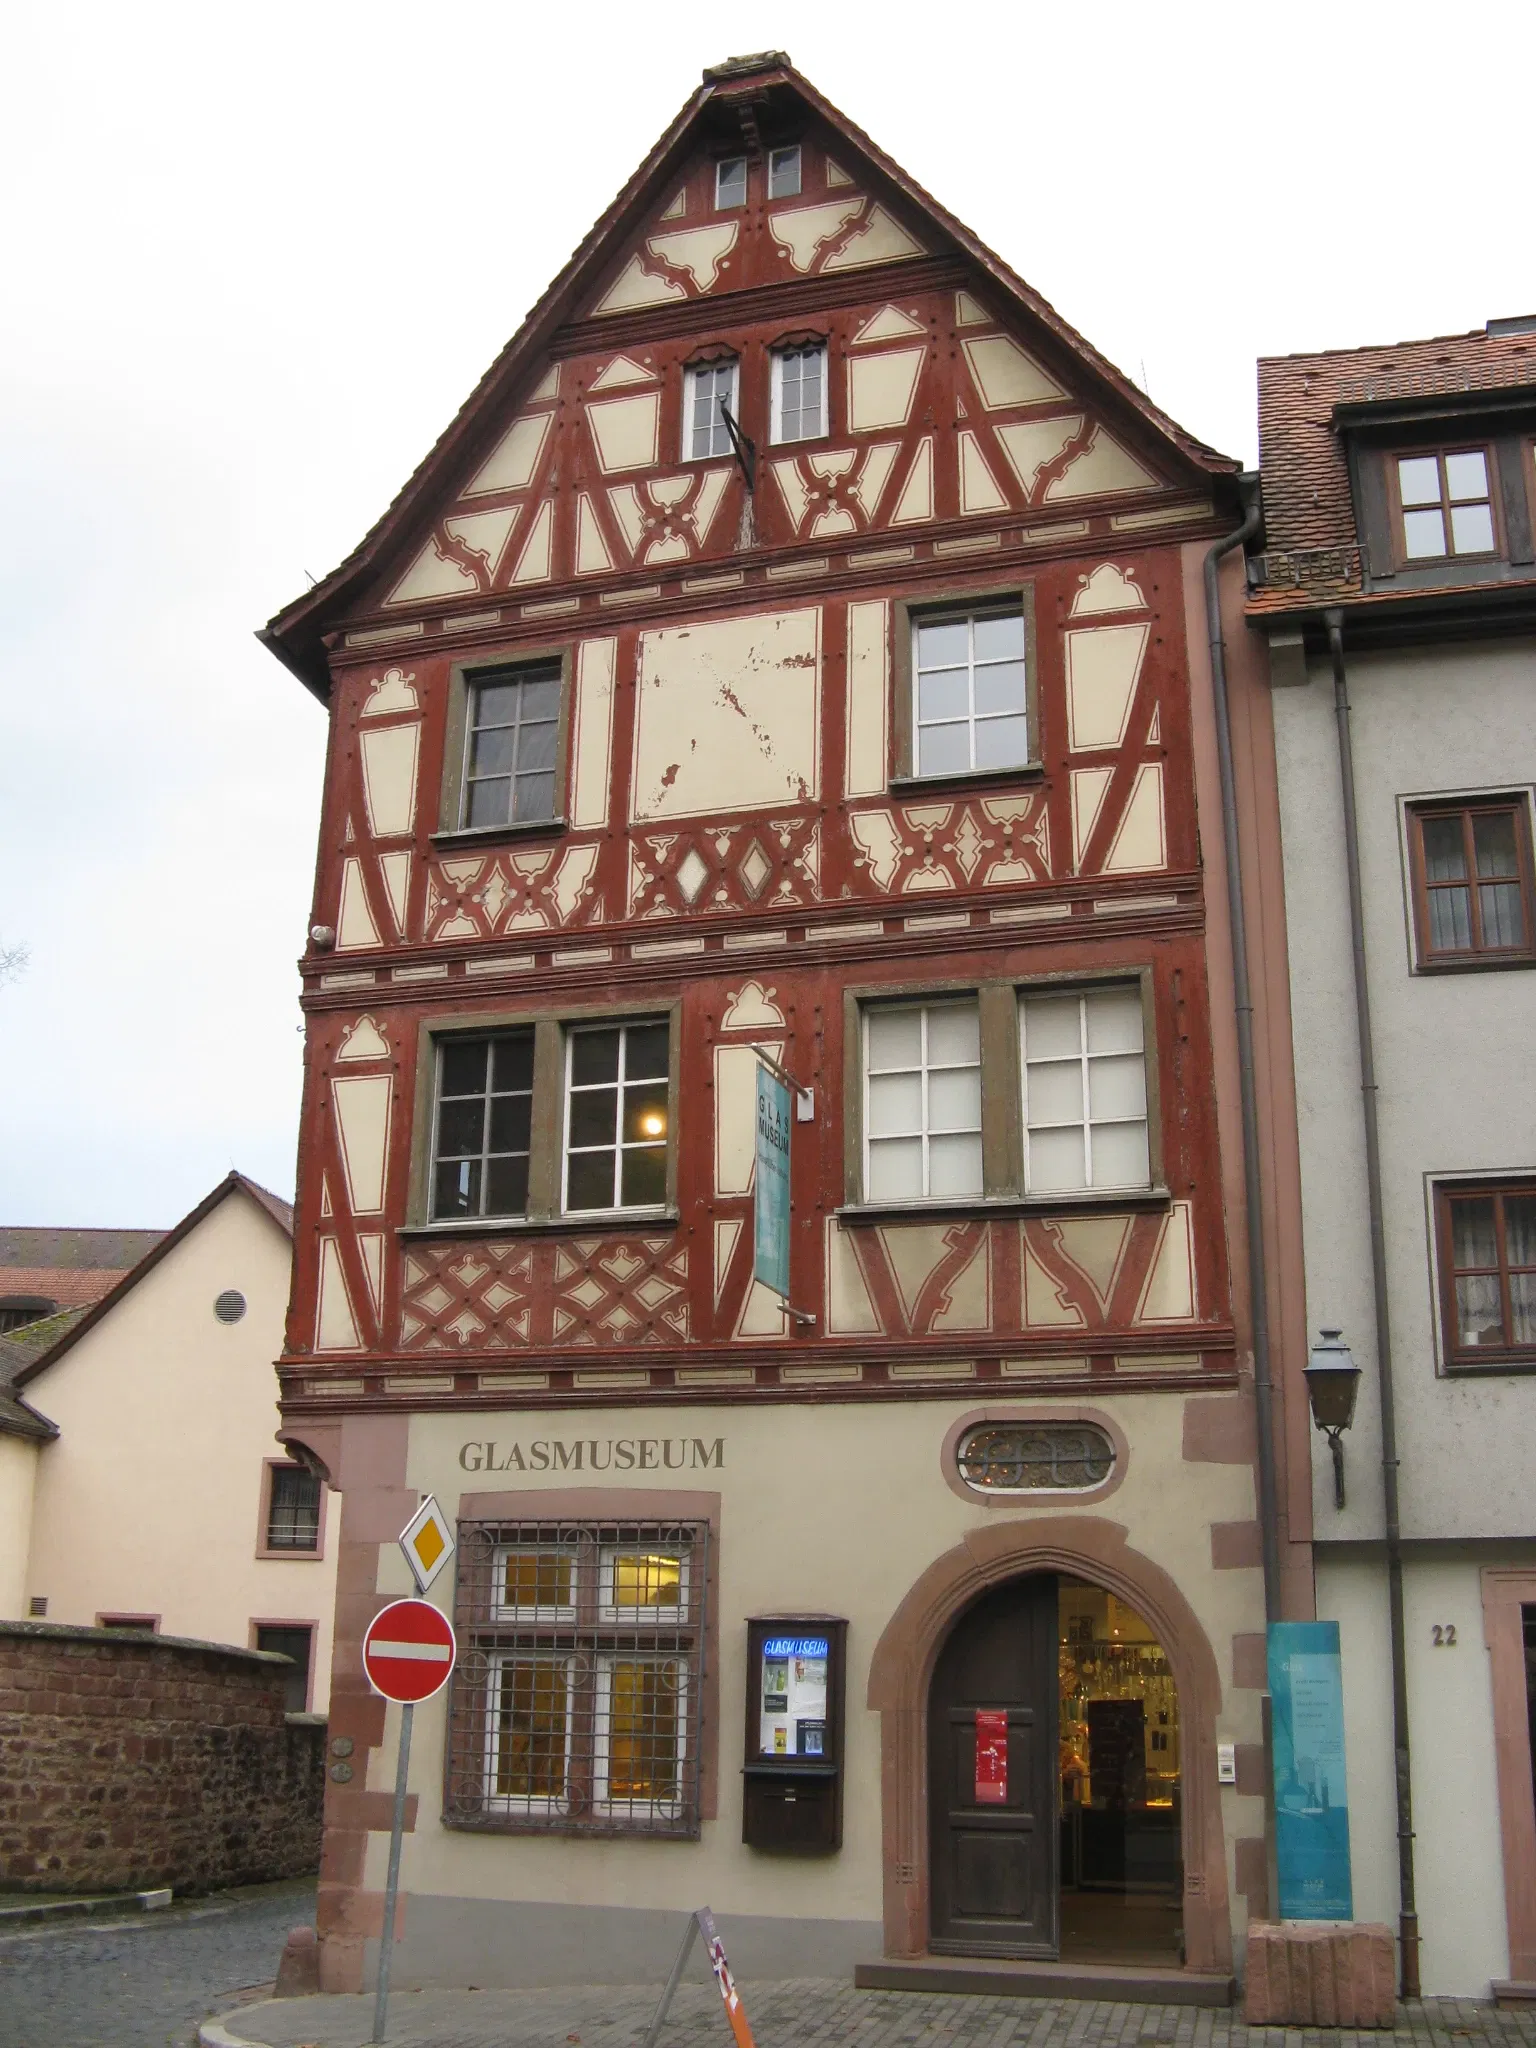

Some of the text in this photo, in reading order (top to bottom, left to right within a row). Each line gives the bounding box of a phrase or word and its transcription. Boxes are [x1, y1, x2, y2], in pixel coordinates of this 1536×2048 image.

[759, 1095, 789, 1134] GLAS
[759, 1117, 789, 1156] MUSEUM
[458, 1438, 728, 1472] GLASMUSEUM
[764, 1640, 828, 1656] GLASMUSEUM
[1431, 1624, 1457, 1646] 22
